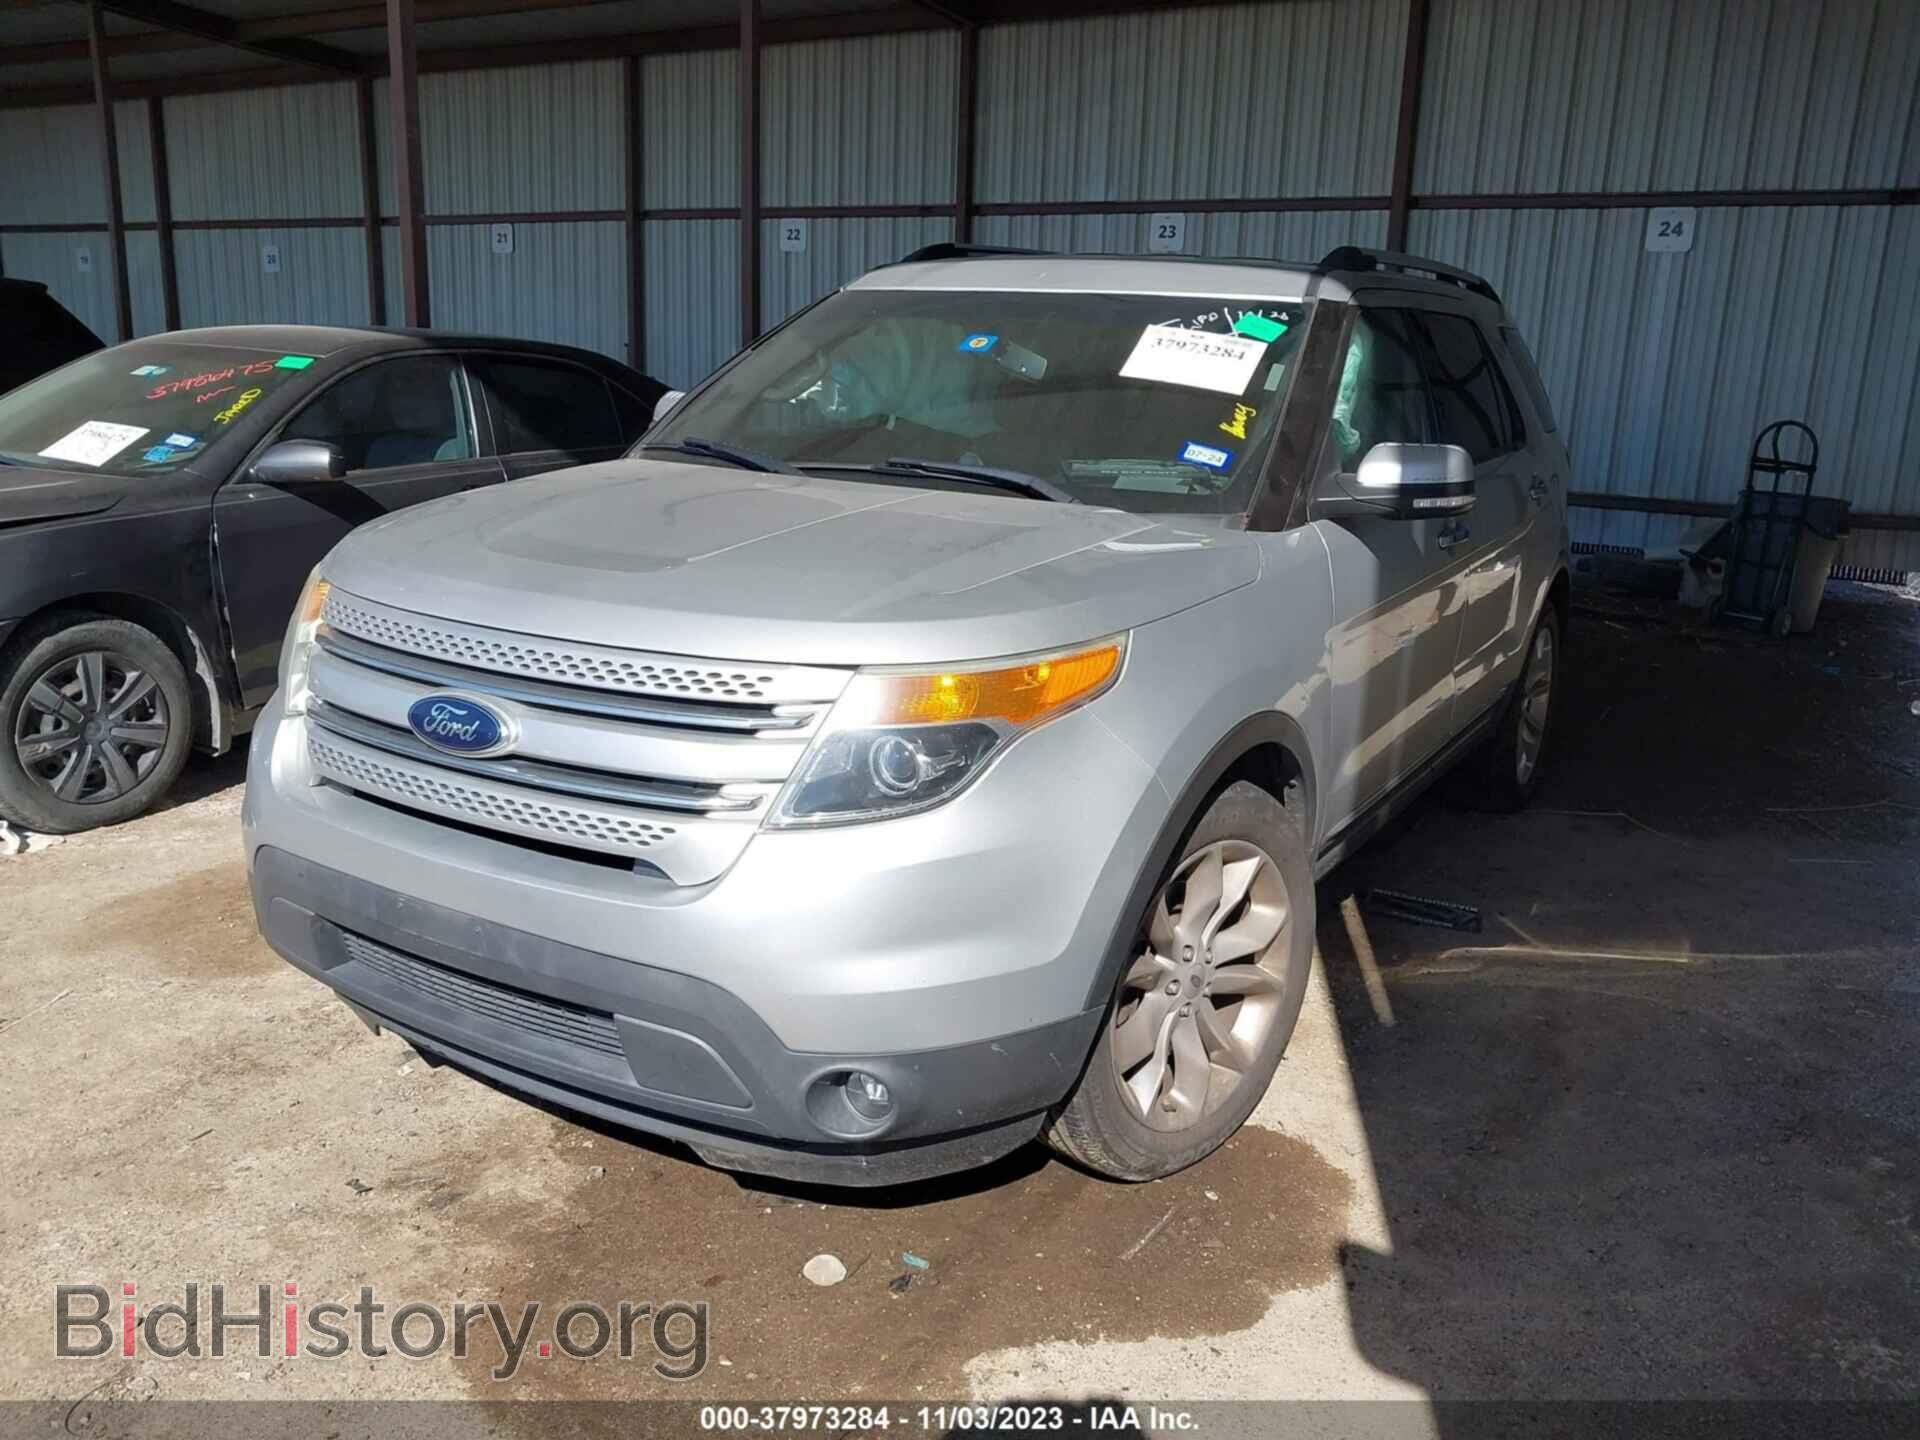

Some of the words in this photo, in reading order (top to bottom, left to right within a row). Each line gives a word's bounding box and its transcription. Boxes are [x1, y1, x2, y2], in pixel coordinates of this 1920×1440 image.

[786, 228, 801, 241] 22
[1158, 224, 1176, 239] 23
[1658, 221, 1683, 237] 24
[497, 232, 508, 244] 21
[1150, 337, 1247, 361] 37973284
[423, 703, 480, 742] Ford
